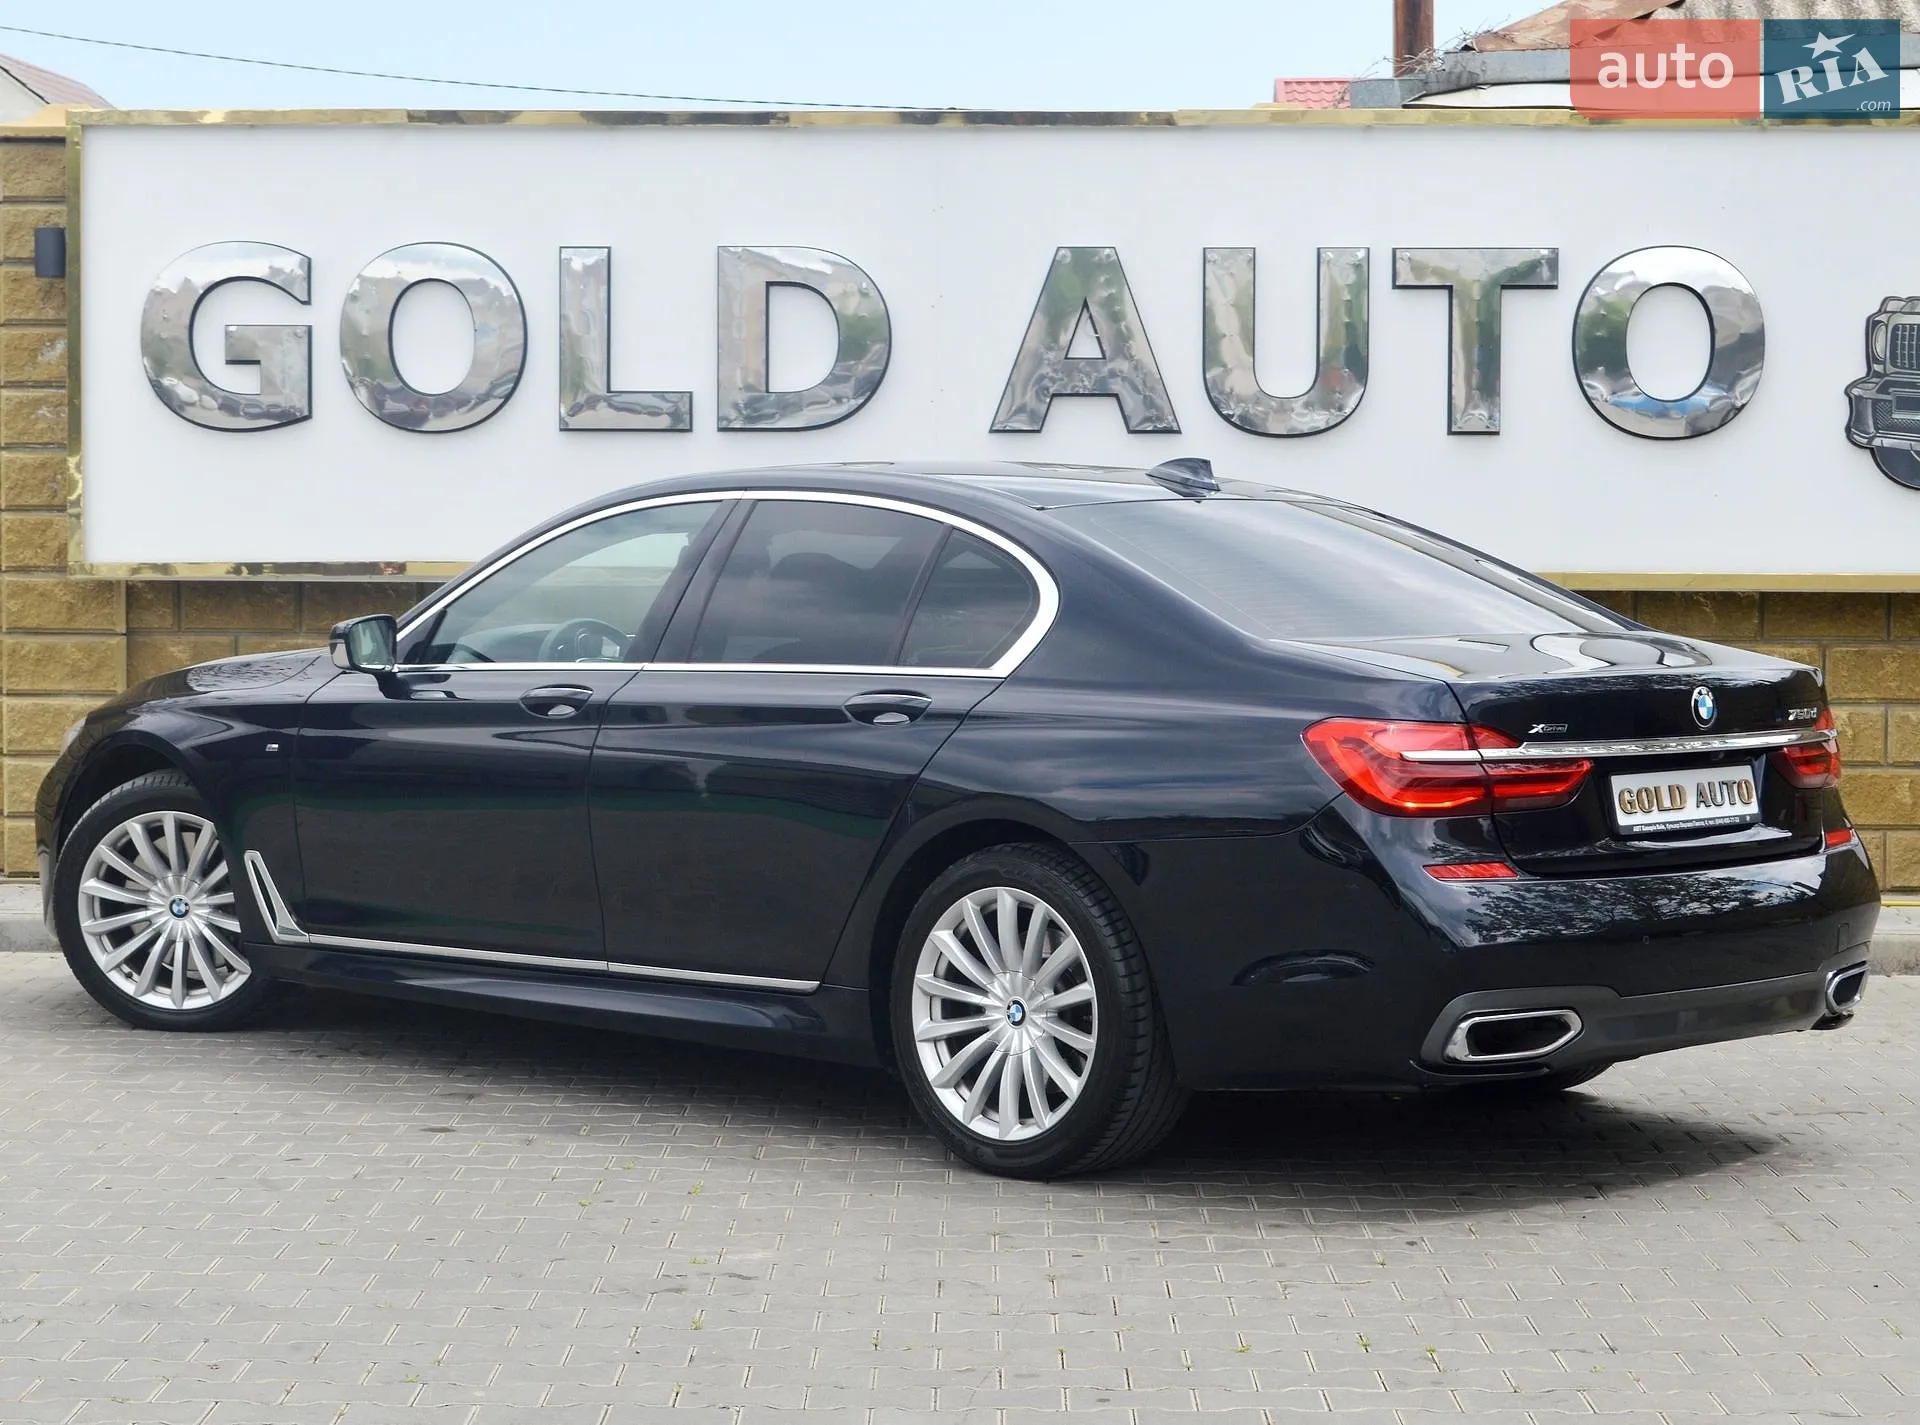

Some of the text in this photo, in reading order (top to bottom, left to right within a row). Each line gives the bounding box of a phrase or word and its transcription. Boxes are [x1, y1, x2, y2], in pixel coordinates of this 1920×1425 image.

[140, 240, 1767, 440] GOLD AUTO
[1619, 778, 1754, 814] GOLD AUTO
